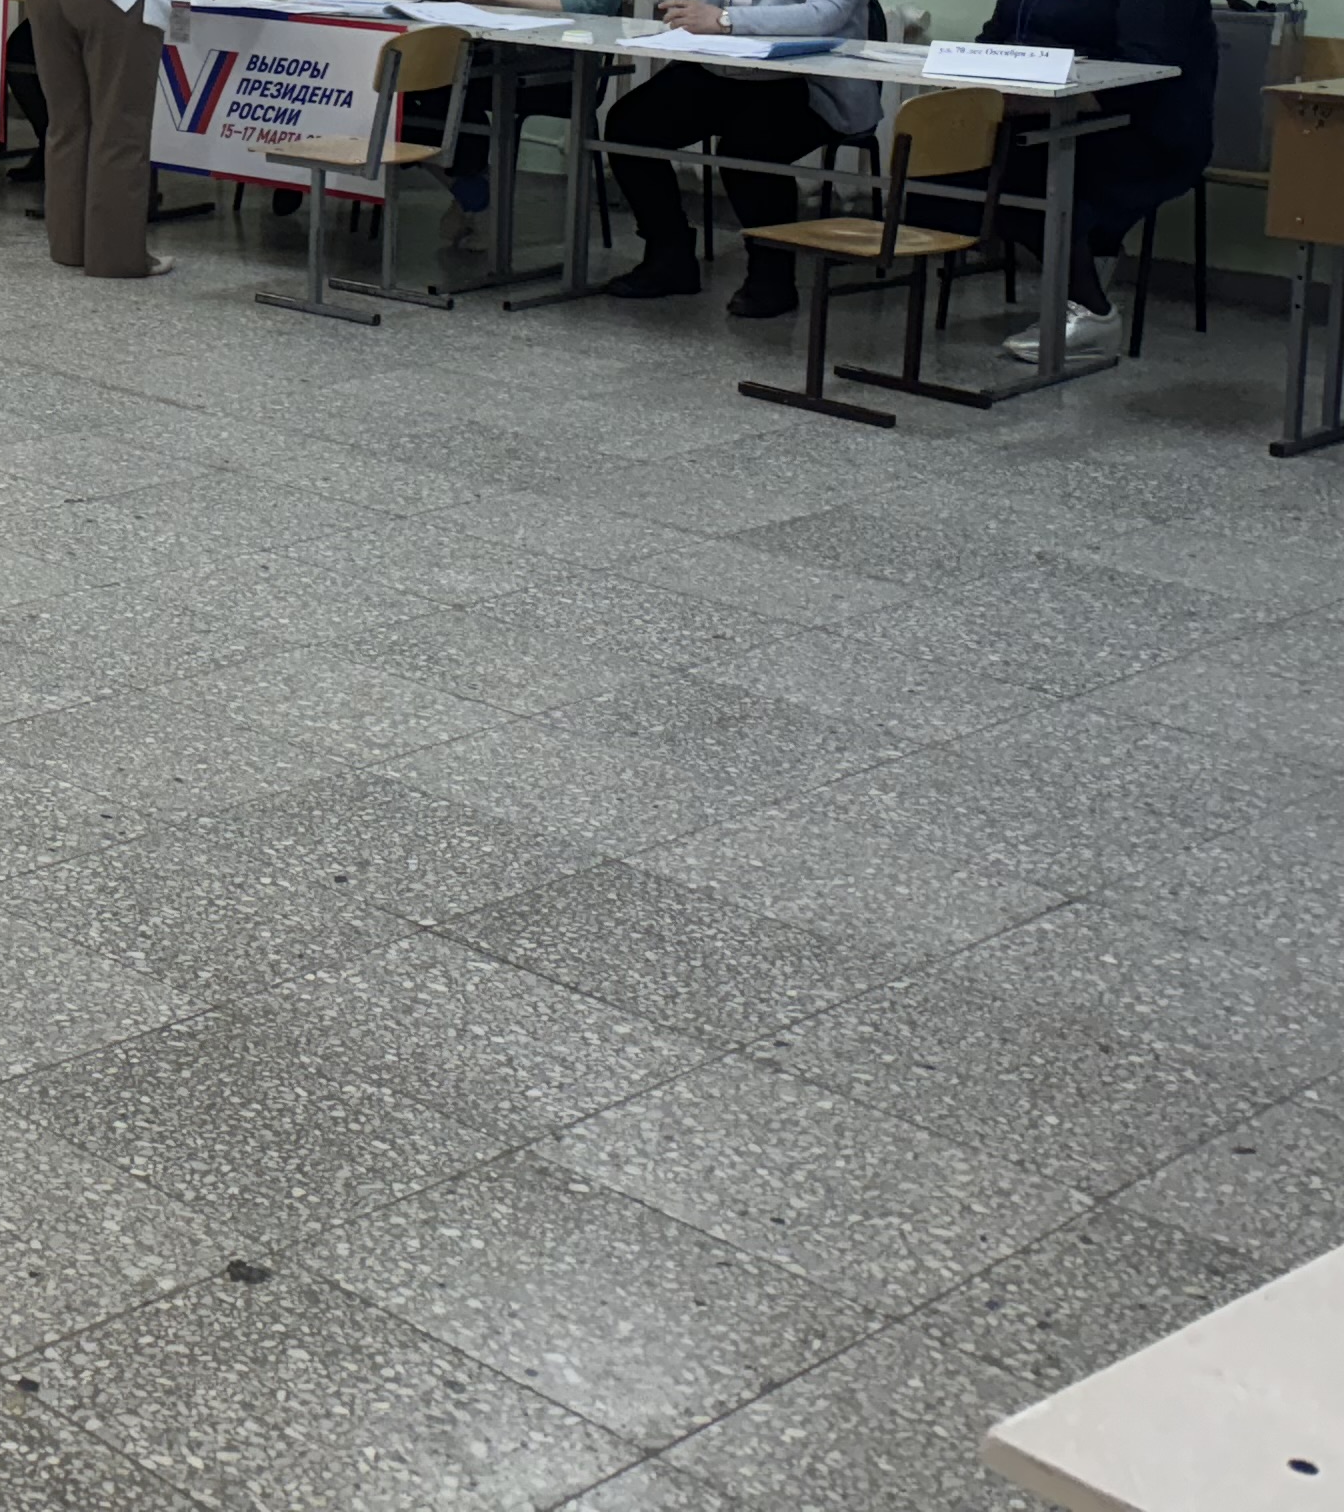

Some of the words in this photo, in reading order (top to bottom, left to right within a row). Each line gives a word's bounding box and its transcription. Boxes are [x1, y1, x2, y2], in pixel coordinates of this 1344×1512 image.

[956, 46, 965, 54] 70
[1038, 50, 1049, 58] 34
[246, 54, 329, 79] ВЫБОРЫ
[236, 78, 354, 108] ПРЕЗИДЕНТА
[226, 101, 302, 126] РОССИИ
